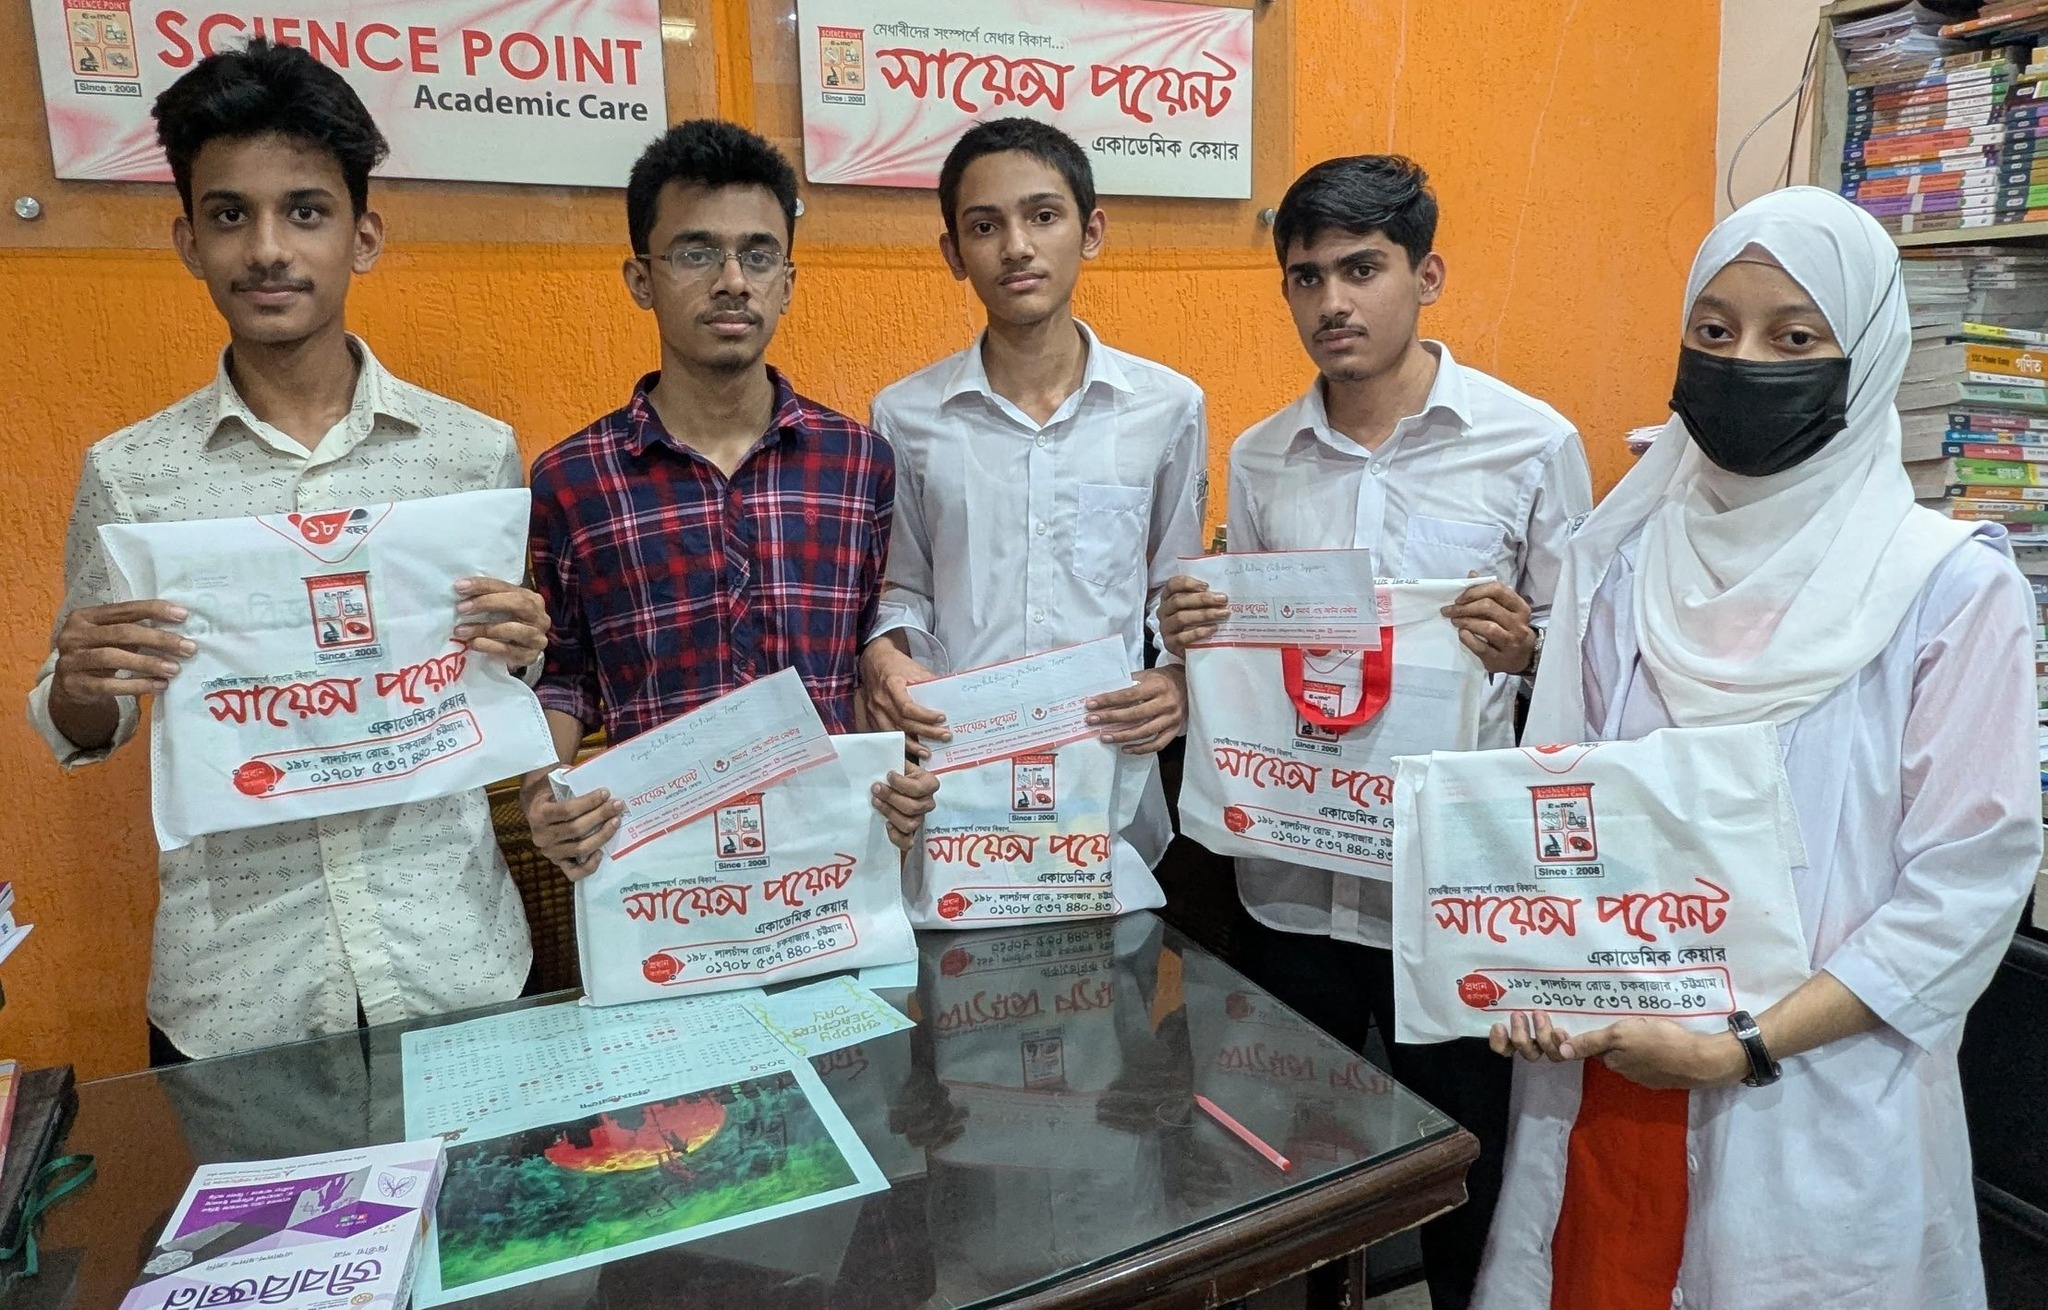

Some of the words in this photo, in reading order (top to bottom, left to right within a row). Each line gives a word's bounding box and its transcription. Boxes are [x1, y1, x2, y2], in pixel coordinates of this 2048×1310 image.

[873, 21, 929, 39] মেধাবীদের
[984, 31, 1015, 46] মেধার
[462, 29, 643, 85] POINT
[79, 83, 106, 92] Since
[114, 84, 137, 93] 2008
[876, 48, 1076, 113] সায়েন্স
[1090, 50, 1237, 123] পয়েন্ট
[414, 84, 570, 117] Academic
[579, 94, 648, 121] Care
[1092, 132, 1182, 159] একাডেমিক
[1189, 140, 1240, 161] কেয়ার
[307, 520, 338, 538] ১৮
[318, 652, 346, 662] Since
[354, 648, 378, 656] 2008
[204, 678, 362, 727] সায়েন্স
[369, 708, 436, 736] একাডেমিক
[438, 693, 468, 716] কেয়ার
[1294, 741, 1316, 750] Since
[310, 764, 366, 783] ০১৭০৮
[372, 757, 406, 774] ৫৩৭
[411, 737, 458, 765] ৪৪০-৪৩
[1214, 748, 1322, 794] সায়েন্স
[1011, 814, 1032, 822] Since
[1038, 814, 1056, 822] 2008
[1318, 806, 1378, 826] একাডেমিক
[926, 833, 1040, 868] সায়েন্স
[1270, 830, 1311, 846] ০১৭০৮
[1315, 837, 1342, 852] ৫৩৭
[718, 862, 742, 870] Since
[748, 858, 767, 867] 2008
[1538, 867, 1568, 876] Since
[1576, 866, 1600, 876] 2008
[622, 884, 753, 924] সায়েন্স
[763, 852, 857, 906] পয়েন্ট
[1038, 870, 1096, 884] একাডেমিক
[755, 908, 812, 935] একাডেমিক
[815, 899, 849, 918] কেয়ার
[990, 904, 1030, 915] ০১৭০৮
[1035, 902, 1062, 914] ৫৩৭
[1066, 902, 1112, 912] ৪৪০-৪৩
[1431, 894, 1582, 943] সায়েন্স
[1596, 877, 1730, 942] পয়েন্ট
[706, 959, 752, 974] ০১৭০৮
[756, 952, 782, 970] ৫৩৭
[786, 938, 836, 960] ৪৪০-৪৩
[1587, 944, 1672, 968] একাডেমিক
[1678, 946, 1726, 964] কেয়ার
[1464, 980, 1488, 992] প্রধান
[1532, 993, 1586, 1008] ০১৭০৮
[1594, 994, 1631, 1008] ৫৩৭
[1638, 994, 1706, 1009] ৪৪০-৪৩
[162, 1259, 382, 1310] জীববিজ্ঞান
